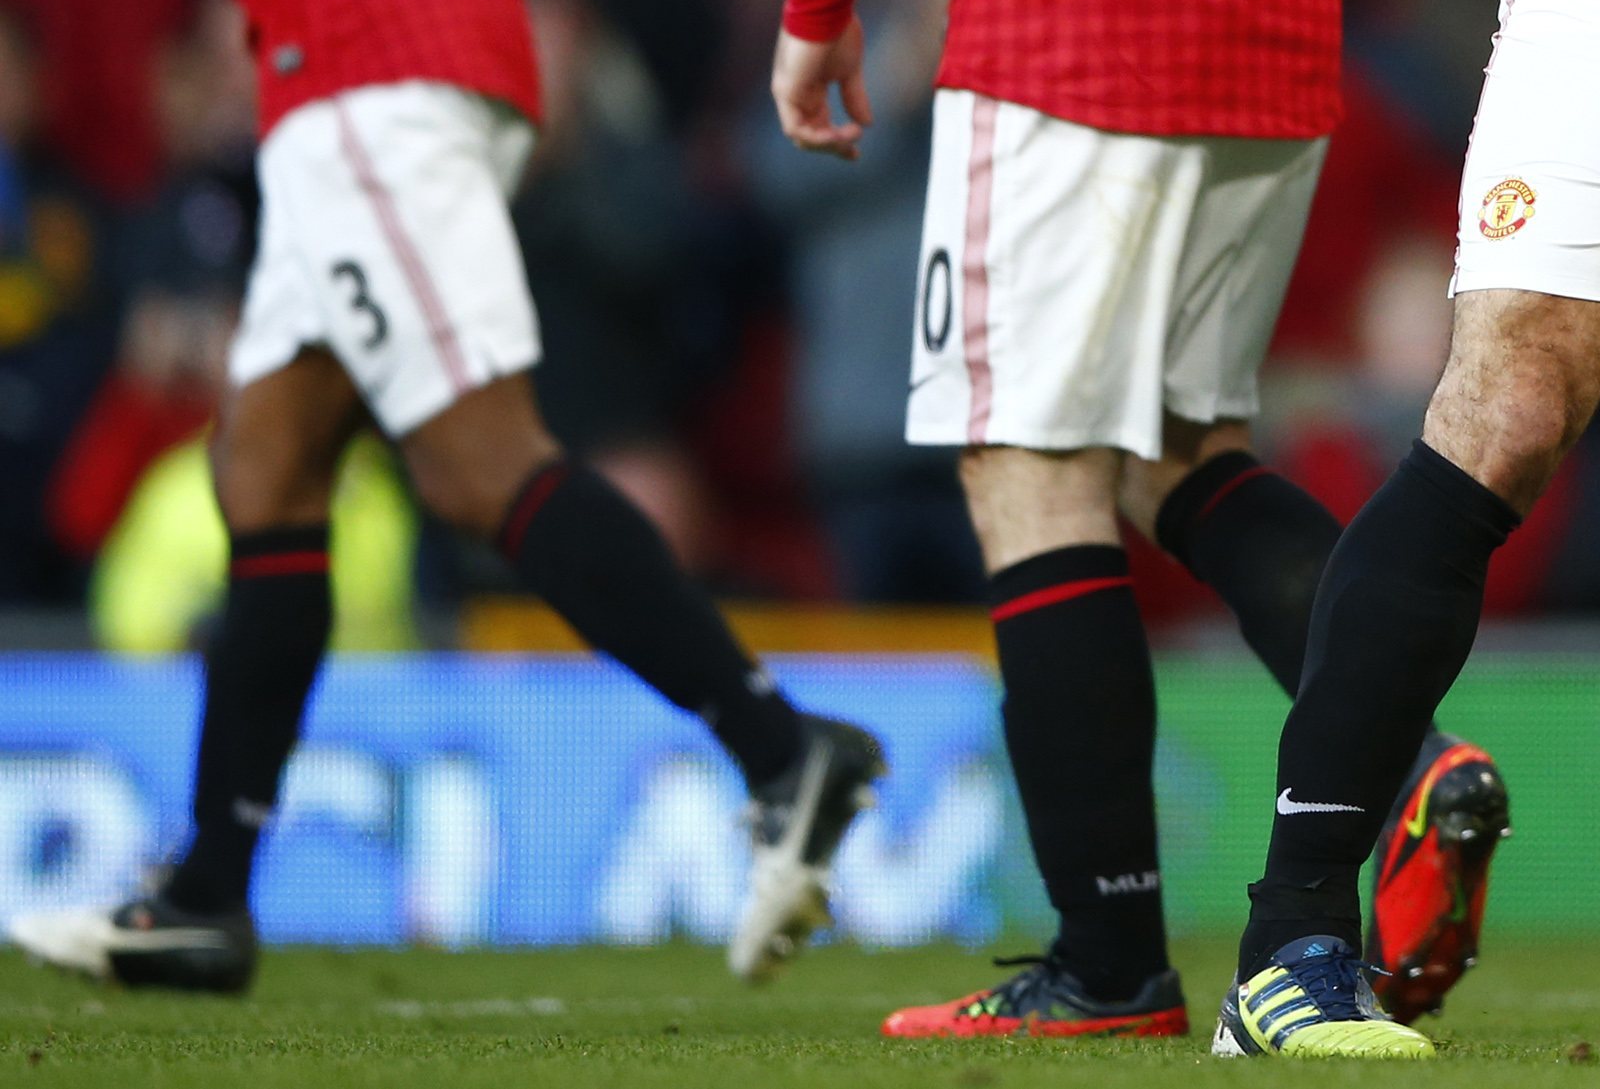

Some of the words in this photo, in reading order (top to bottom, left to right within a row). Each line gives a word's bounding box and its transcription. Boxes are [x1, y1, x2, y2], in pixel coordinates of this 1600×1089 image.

[1485, 179, 1534, 203] MANCHESTER
[1483, 225, 1517, 238] UNITED
[330, 258, 387, 350] 3
